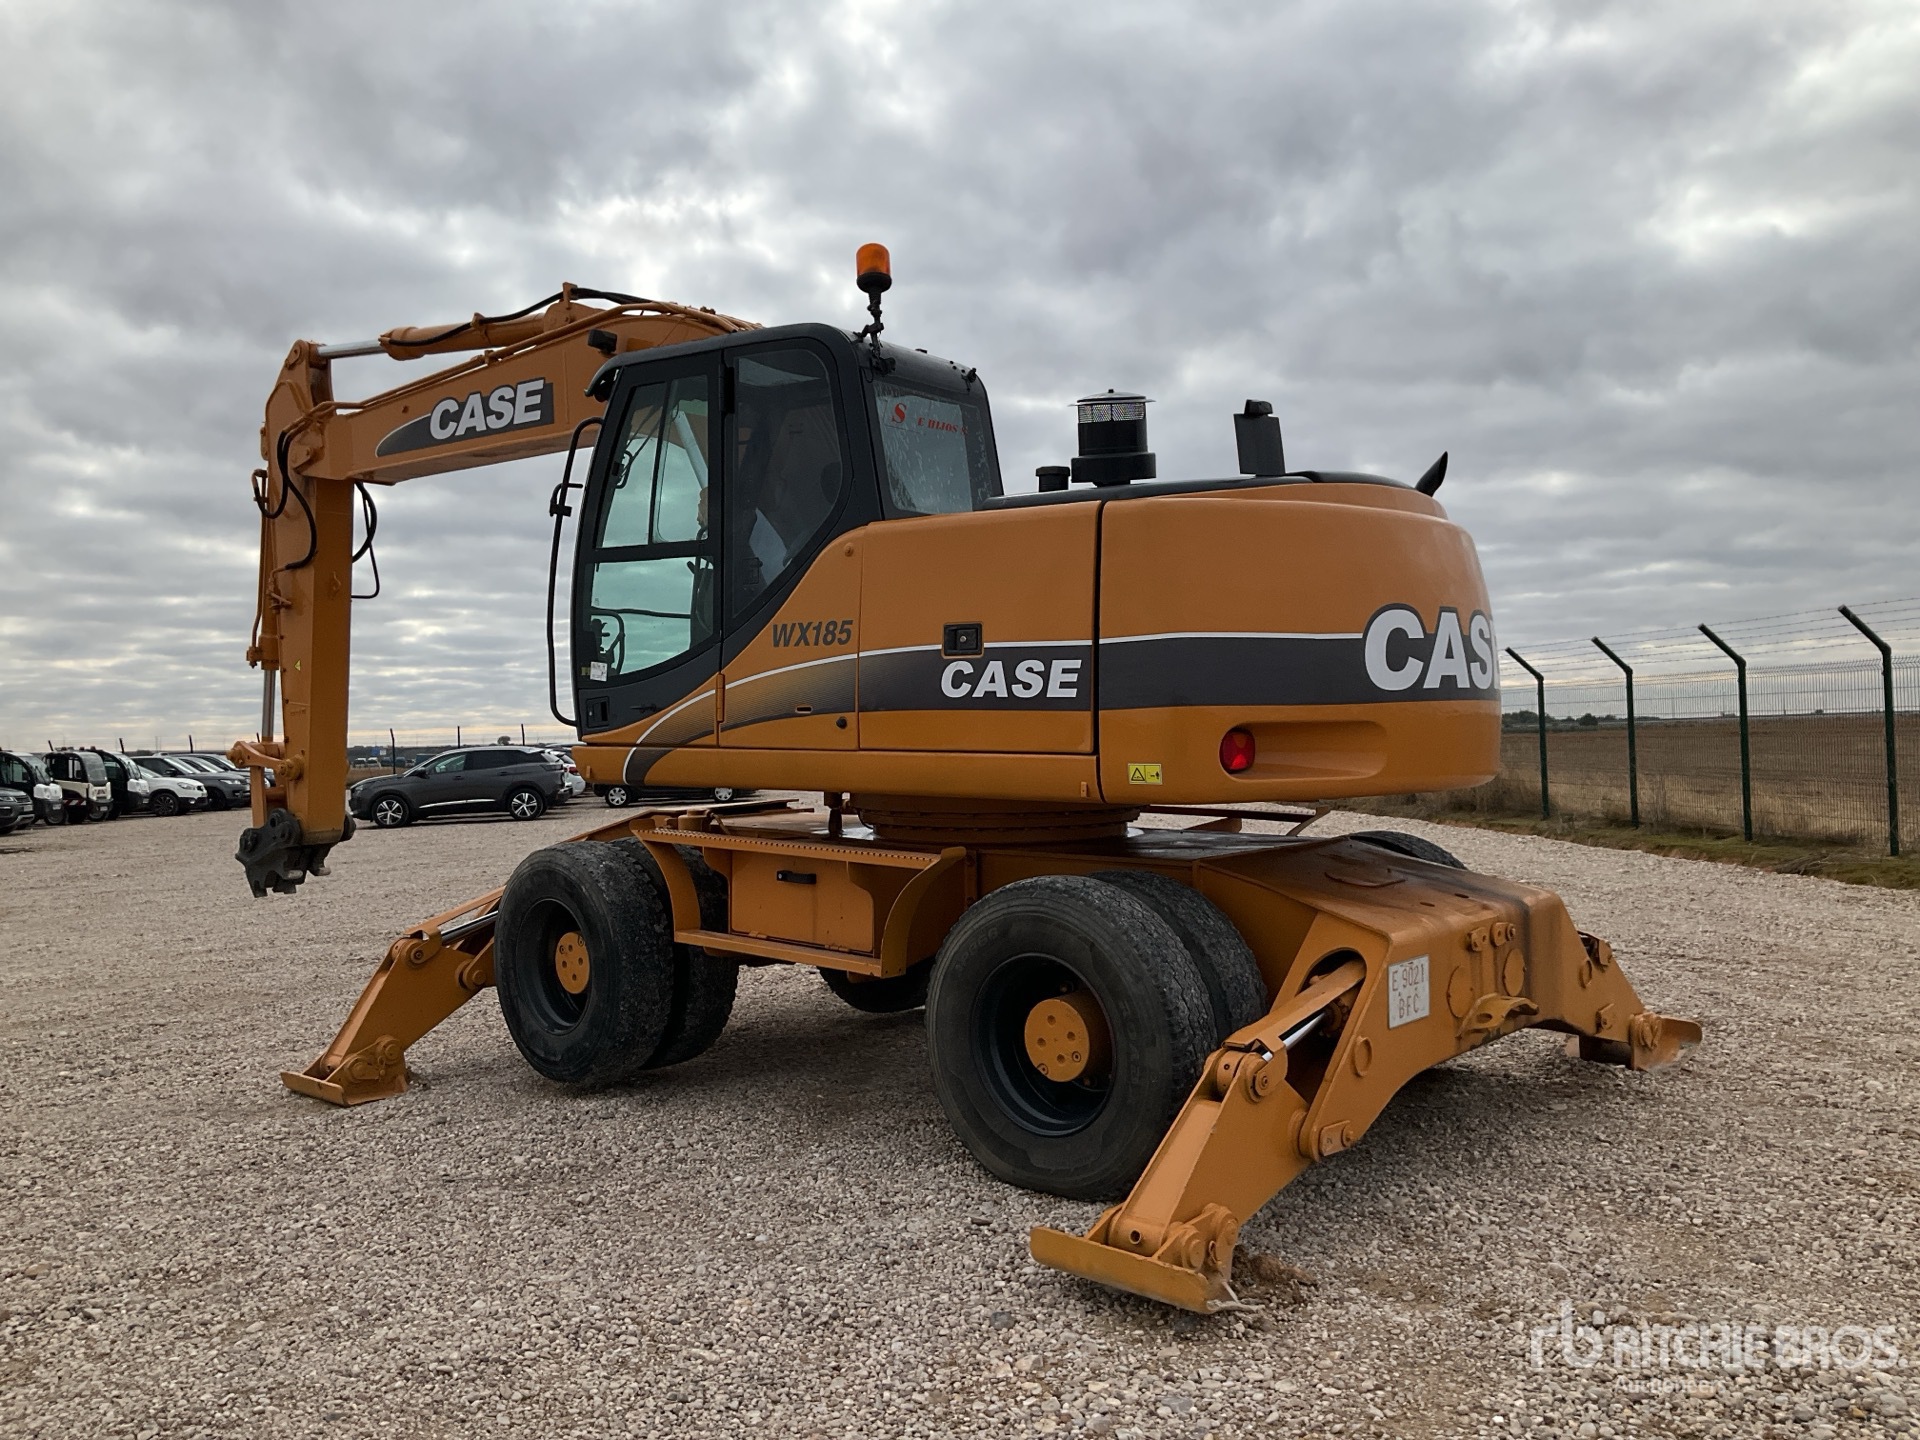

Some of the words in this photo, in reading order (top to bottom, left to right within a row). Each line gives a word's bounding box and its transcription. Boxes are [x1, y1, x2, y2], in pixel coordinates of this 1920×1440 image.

[430, 379, 544, 440] CASE
[772, 620, 853, 647] WX185
[941, 659, 1082, 698] CASE
[1392, 970, 1399, 992] E
[1402, 963, 1425, 989] 9021
